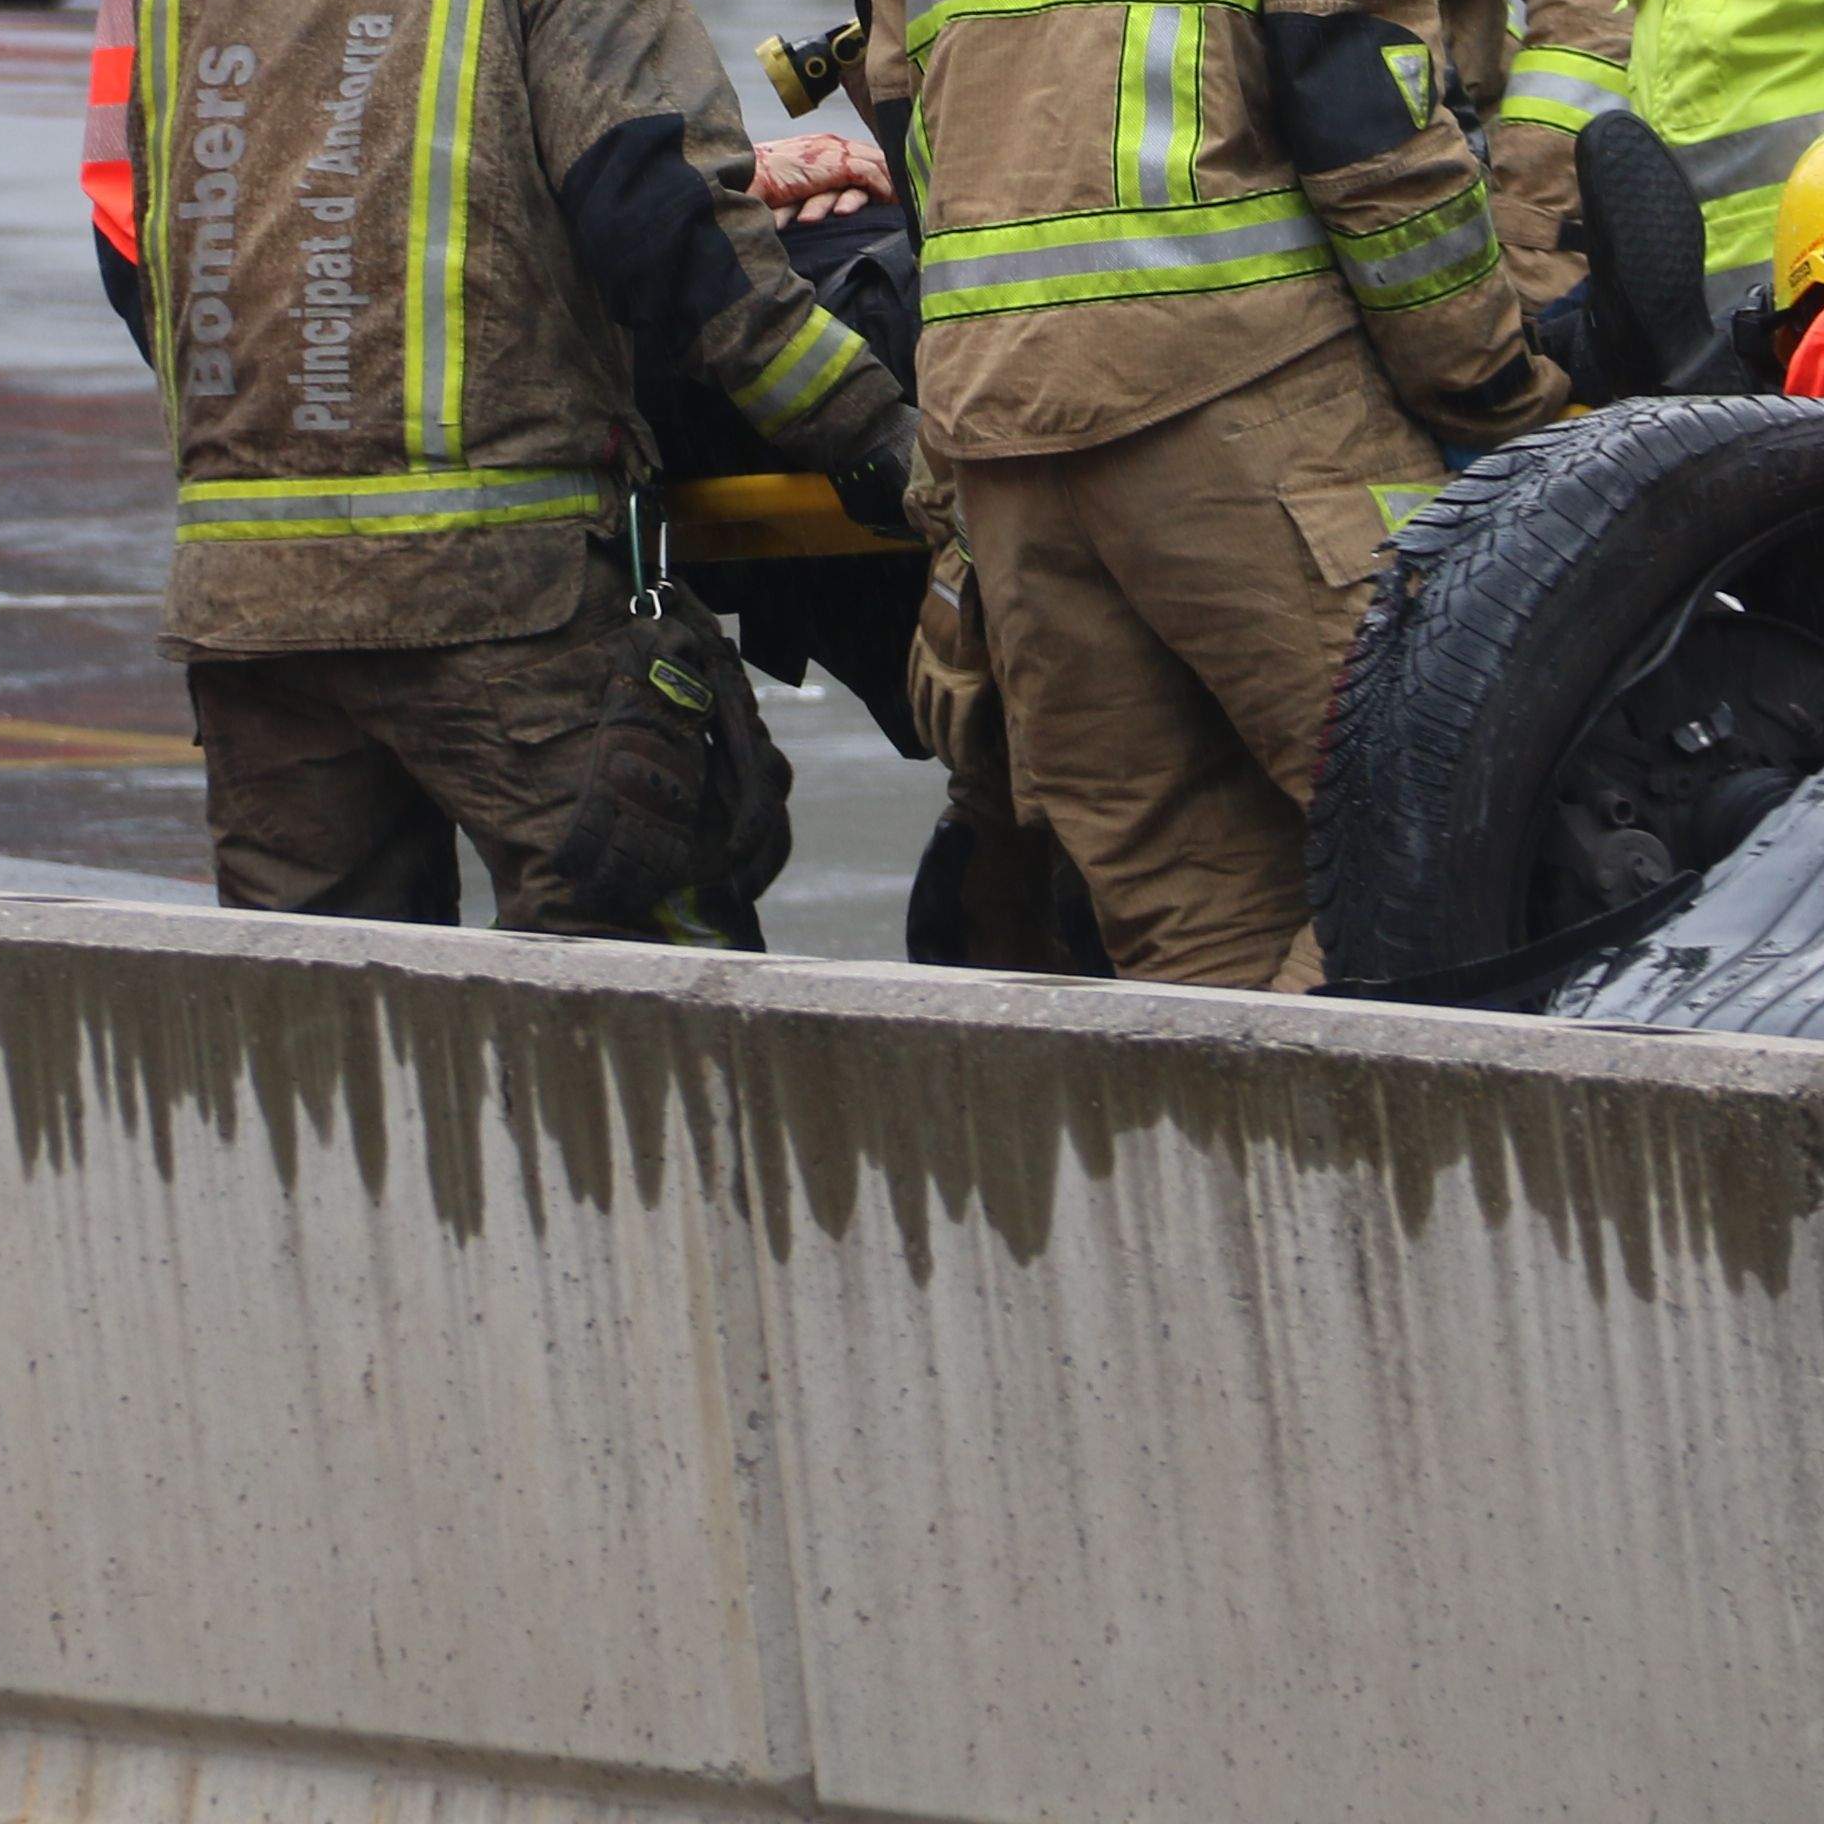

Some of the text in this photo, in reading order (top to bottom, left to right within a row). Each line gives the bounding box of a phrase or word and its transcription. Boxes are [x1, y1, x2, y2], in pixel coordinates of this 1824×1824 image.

[178, 43, 257, 397] Bombers
[286, 12, 394, 432] Principat d'Andorra
